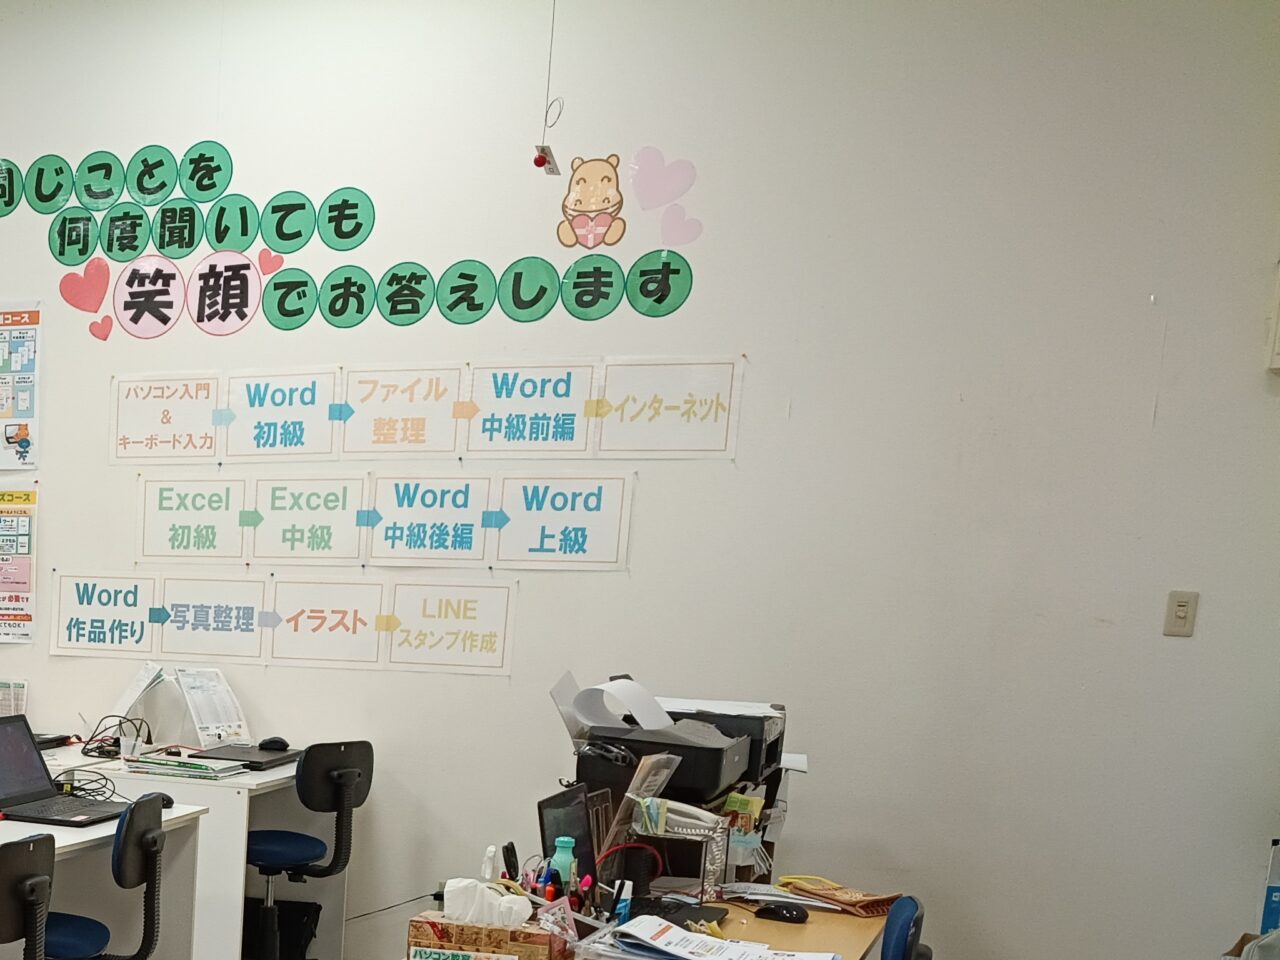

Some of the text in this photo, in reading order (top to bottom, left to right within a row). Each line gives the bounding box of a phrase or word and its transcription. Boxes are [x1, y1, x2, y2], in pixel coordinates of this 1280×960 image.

[54, 198, 367, 258] 何度聞いても
[121, 263, 682, 326] 笑顔でお答えします
[125, 382, 211, 401] パソコン入門
[245, 381, 317, 408] Word
[357, 377, 448, 404] ファイル
[492, 372, 572, 400] Word
[160, 409, 173, 424] &
[614, 393, 728, 424] インターネット
[253, 420, 305, 449] 初級
[372, 416, 427, 445] 整理
[481, 411, 576, 443] 中級前編
[117, 434, 214, 452] キーボード入力
[157, 488, 231, 513] Excel
[270, 487, 349, 513] Excel
[394, 483, 471, 511] Word
[522, 485, 603, 513] Word
[168, 524, 218, 551] 初級
[281, 525, 333, 552] 中級
[384, 523, 474, 552] 中級後編
[528, 528, 588, 556] 上級
[75, 582, 139, 608] Word
[170, 603, 255, 633] 写真整理
[285, 608, 368, 635] イラスト
[421, 598, 478, 621] LINE
[66, 617, 146, 645] 作品作り
[398, 627, 498, 655] スタンプ作成
